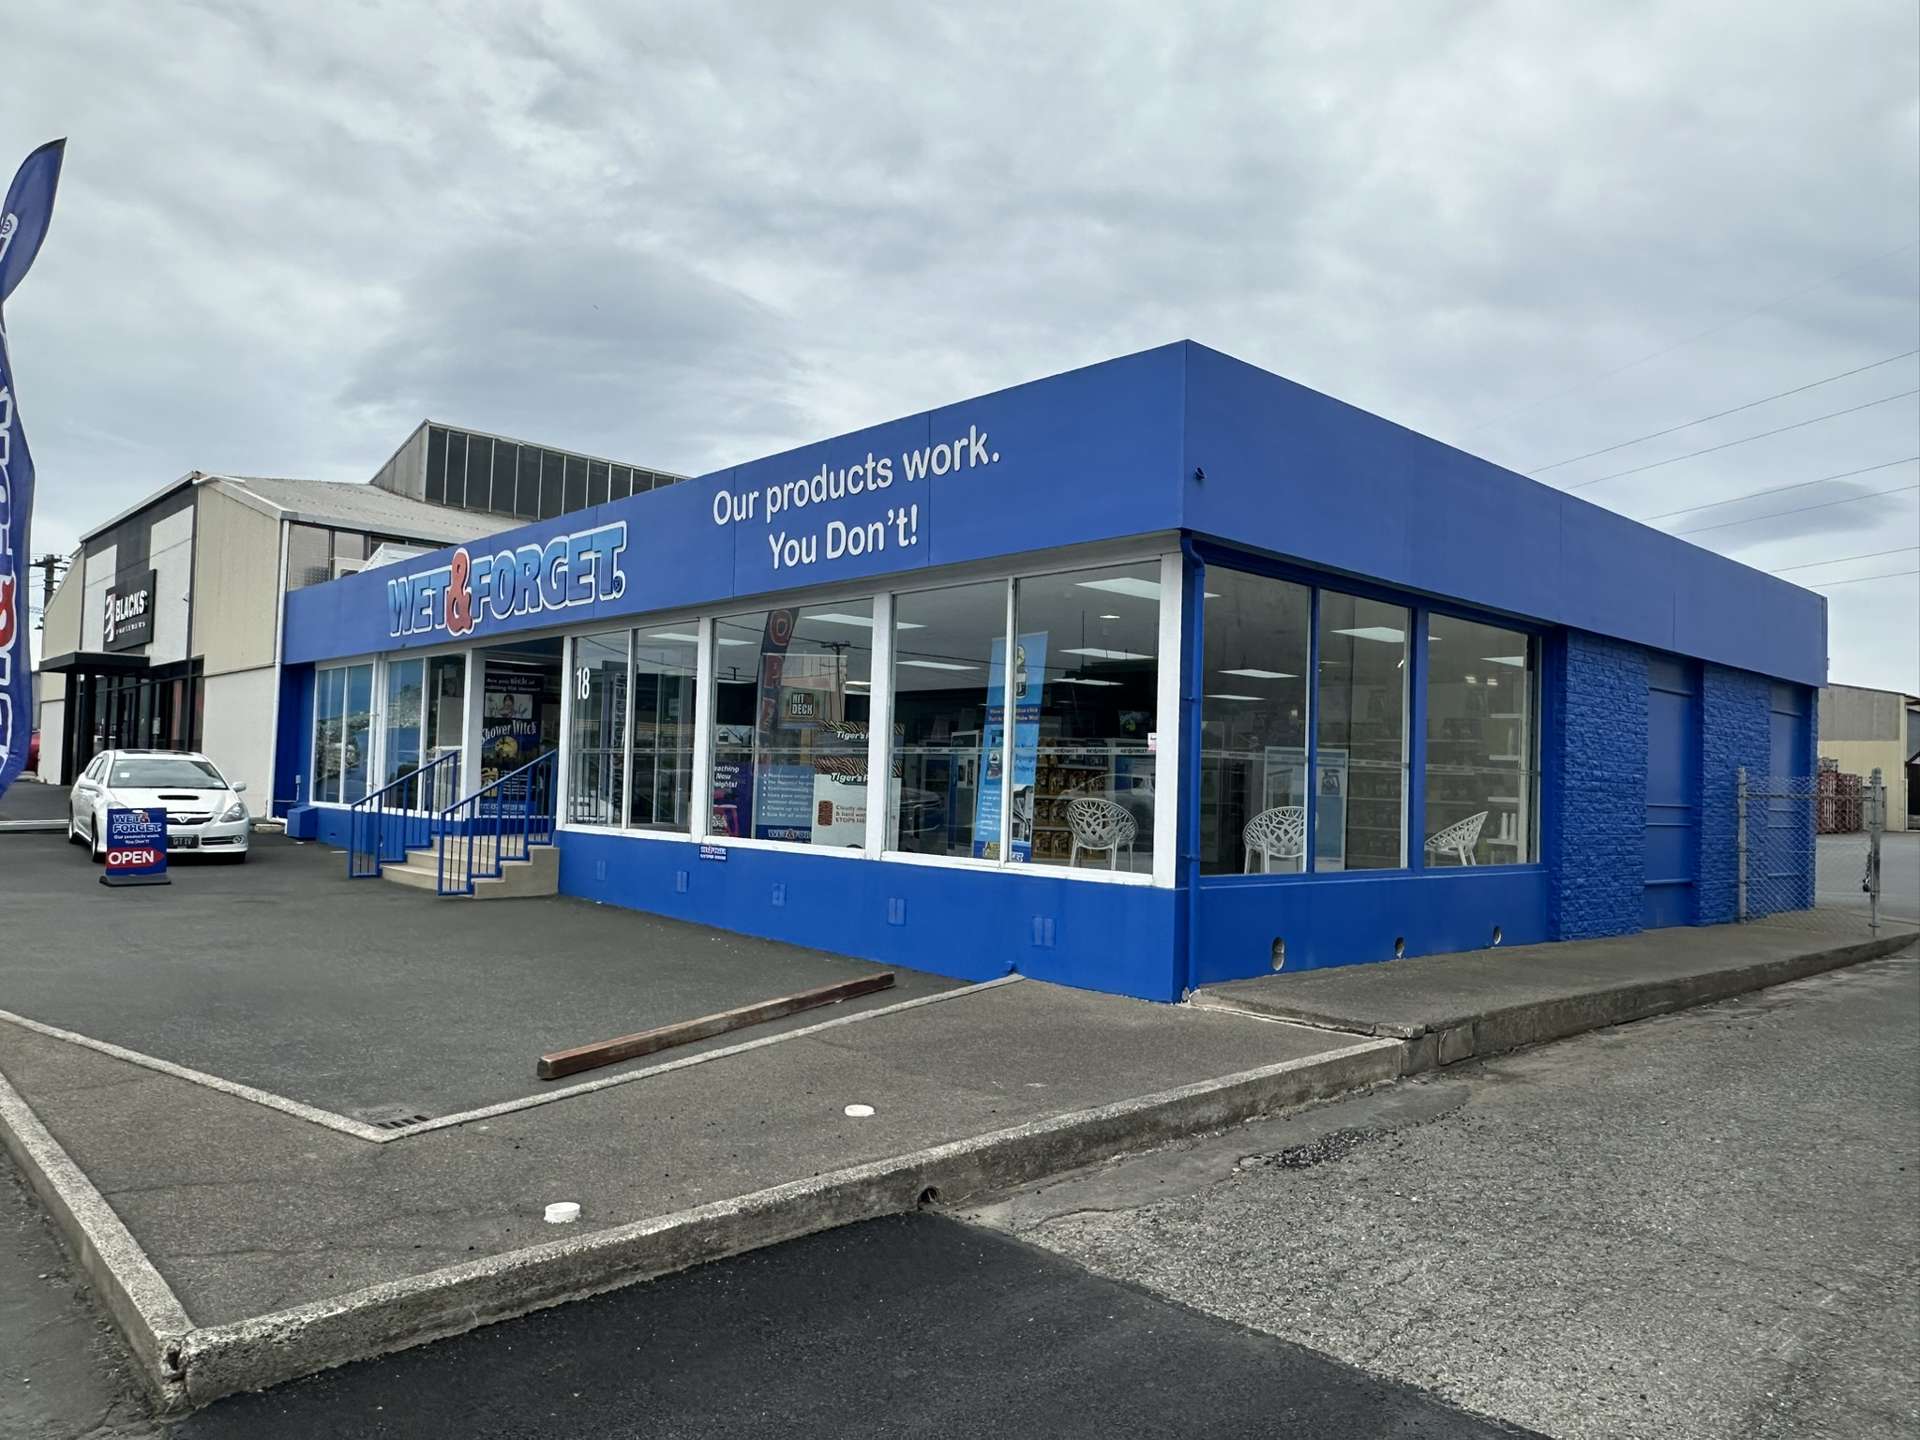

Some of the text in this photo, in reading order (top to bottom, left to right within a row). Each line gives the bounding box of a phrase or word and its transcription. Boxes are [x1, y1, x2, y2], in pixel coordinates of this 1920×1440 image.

[713, 424, 999, 525] Our products work.
[768, 504, 918, 569] You Don't!
[115, 590, 148, 621] BLACKS
[576, 667, 590, 700] 18
[792, 704, 813, 714] DECK
[112, 823, 162, 833] FORGET
[108, 850, 154, 865] OPEN
